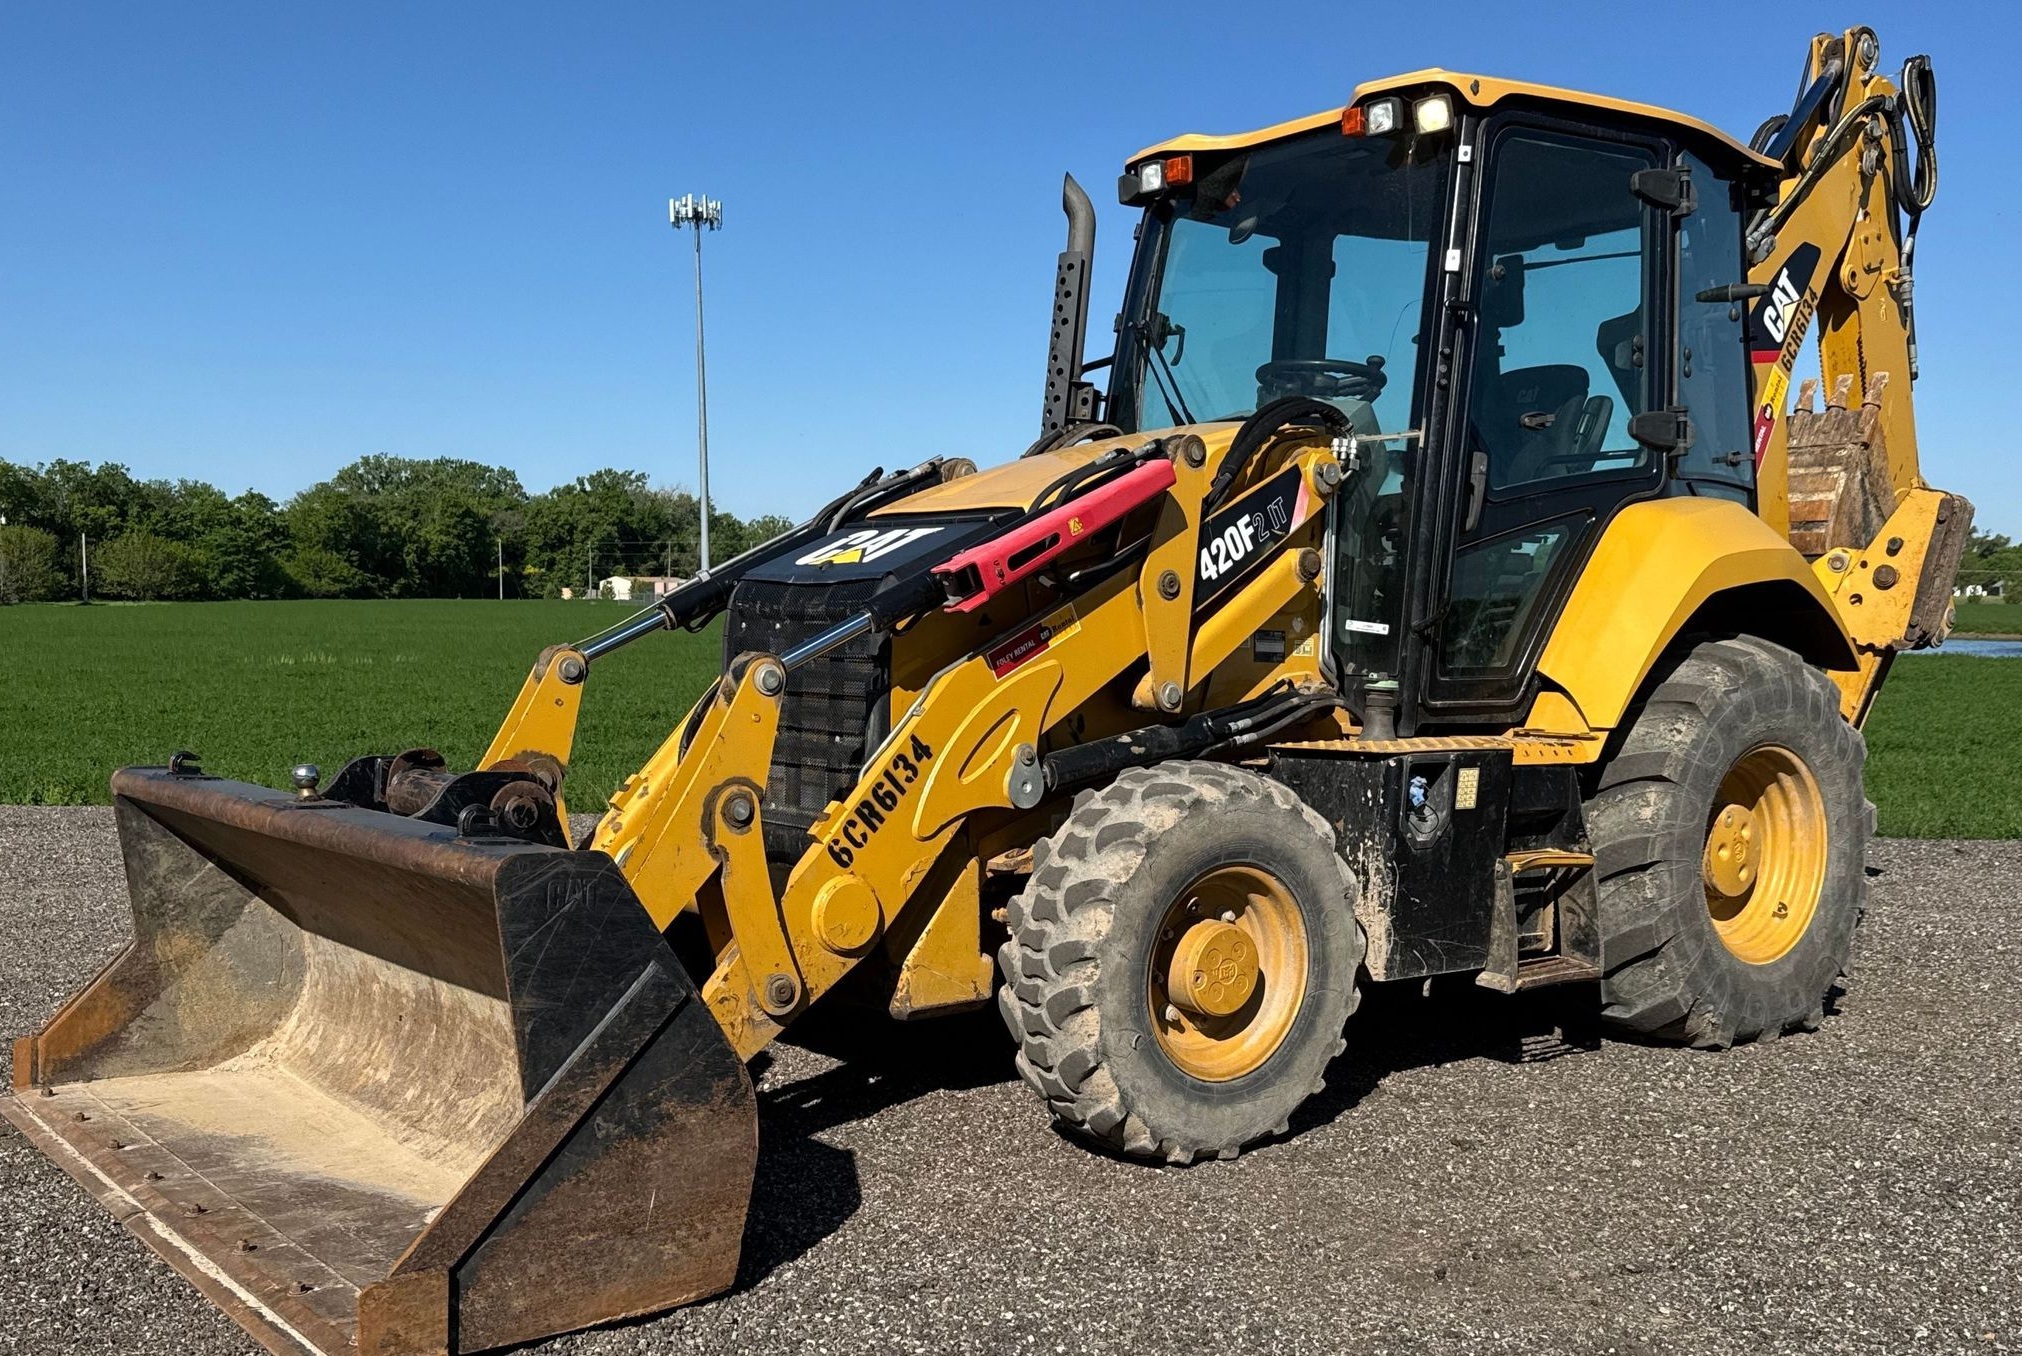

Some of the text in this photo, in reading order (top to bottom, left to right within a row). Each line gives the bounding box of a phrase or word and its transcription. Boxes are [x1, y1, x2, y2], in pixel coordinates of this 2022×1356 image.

[1763, 268, 1800, 343] CAT
[1781, 286, 1818, 372] 6CR6134
[1266, 496, 1288, 530] IT
[795, 527, 945, 565] CAT
[996, 615, 1076, 667] FOLEY RENTAL CAT Rental
[827, 734, 934, 868] 6CR6134
[546, 878, 598, 914] CAT
